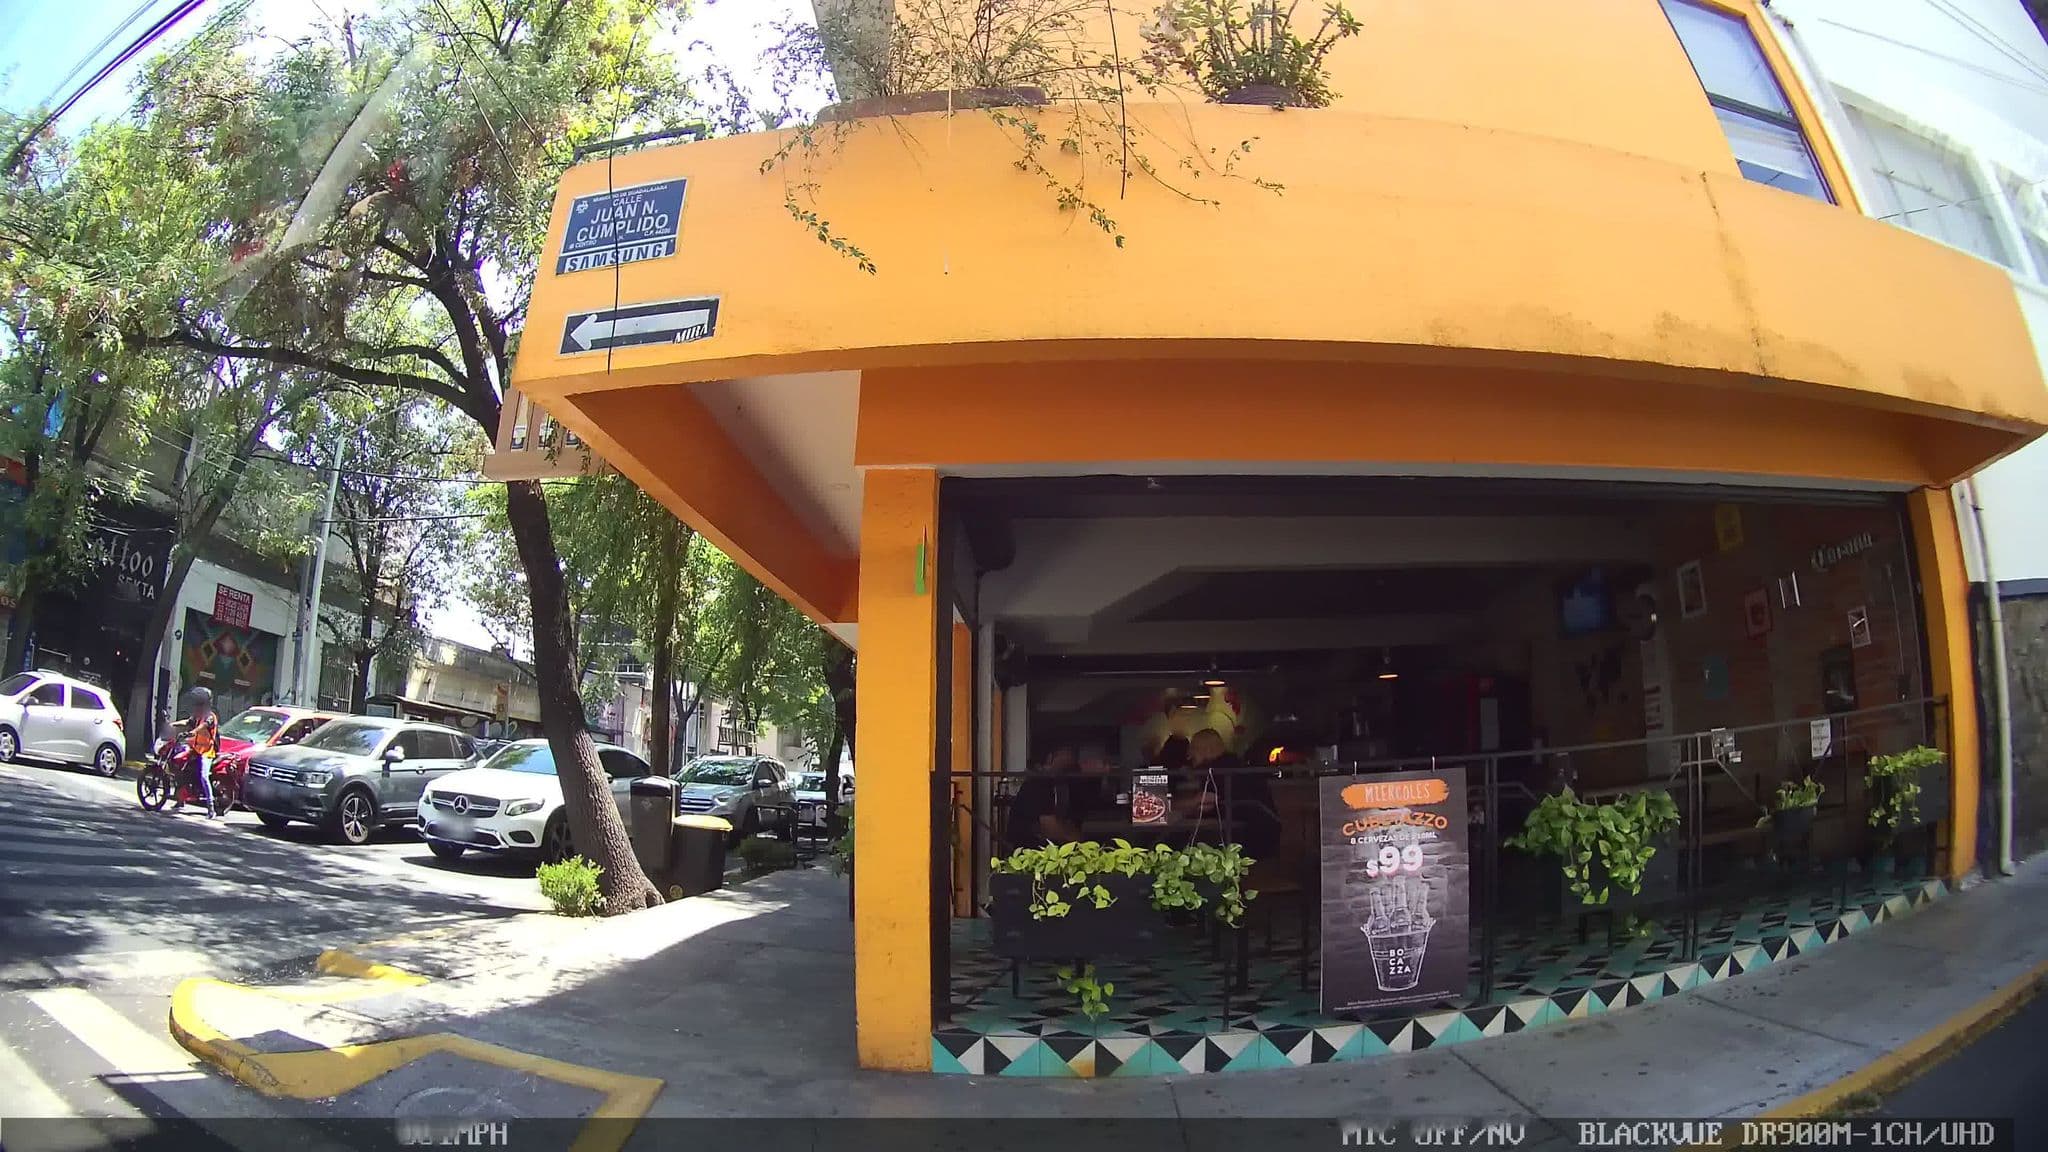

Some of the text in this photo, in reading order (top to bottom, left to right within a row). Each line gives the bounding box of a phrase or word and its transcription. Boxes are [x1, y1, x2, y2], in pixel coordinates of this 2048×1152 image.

[612, 195, 643, 207] CALLE
[590, 200, 659, 225] JUAN N.
[576, 213, 669, 242] CUMPLIDO
[567, 243, 664, 272] SAMSUNG
[1389, 948, 1404, 957] BO
[1389, 957, 1404, 966] CA
[1389, 965, 1411, 975] ZZA
